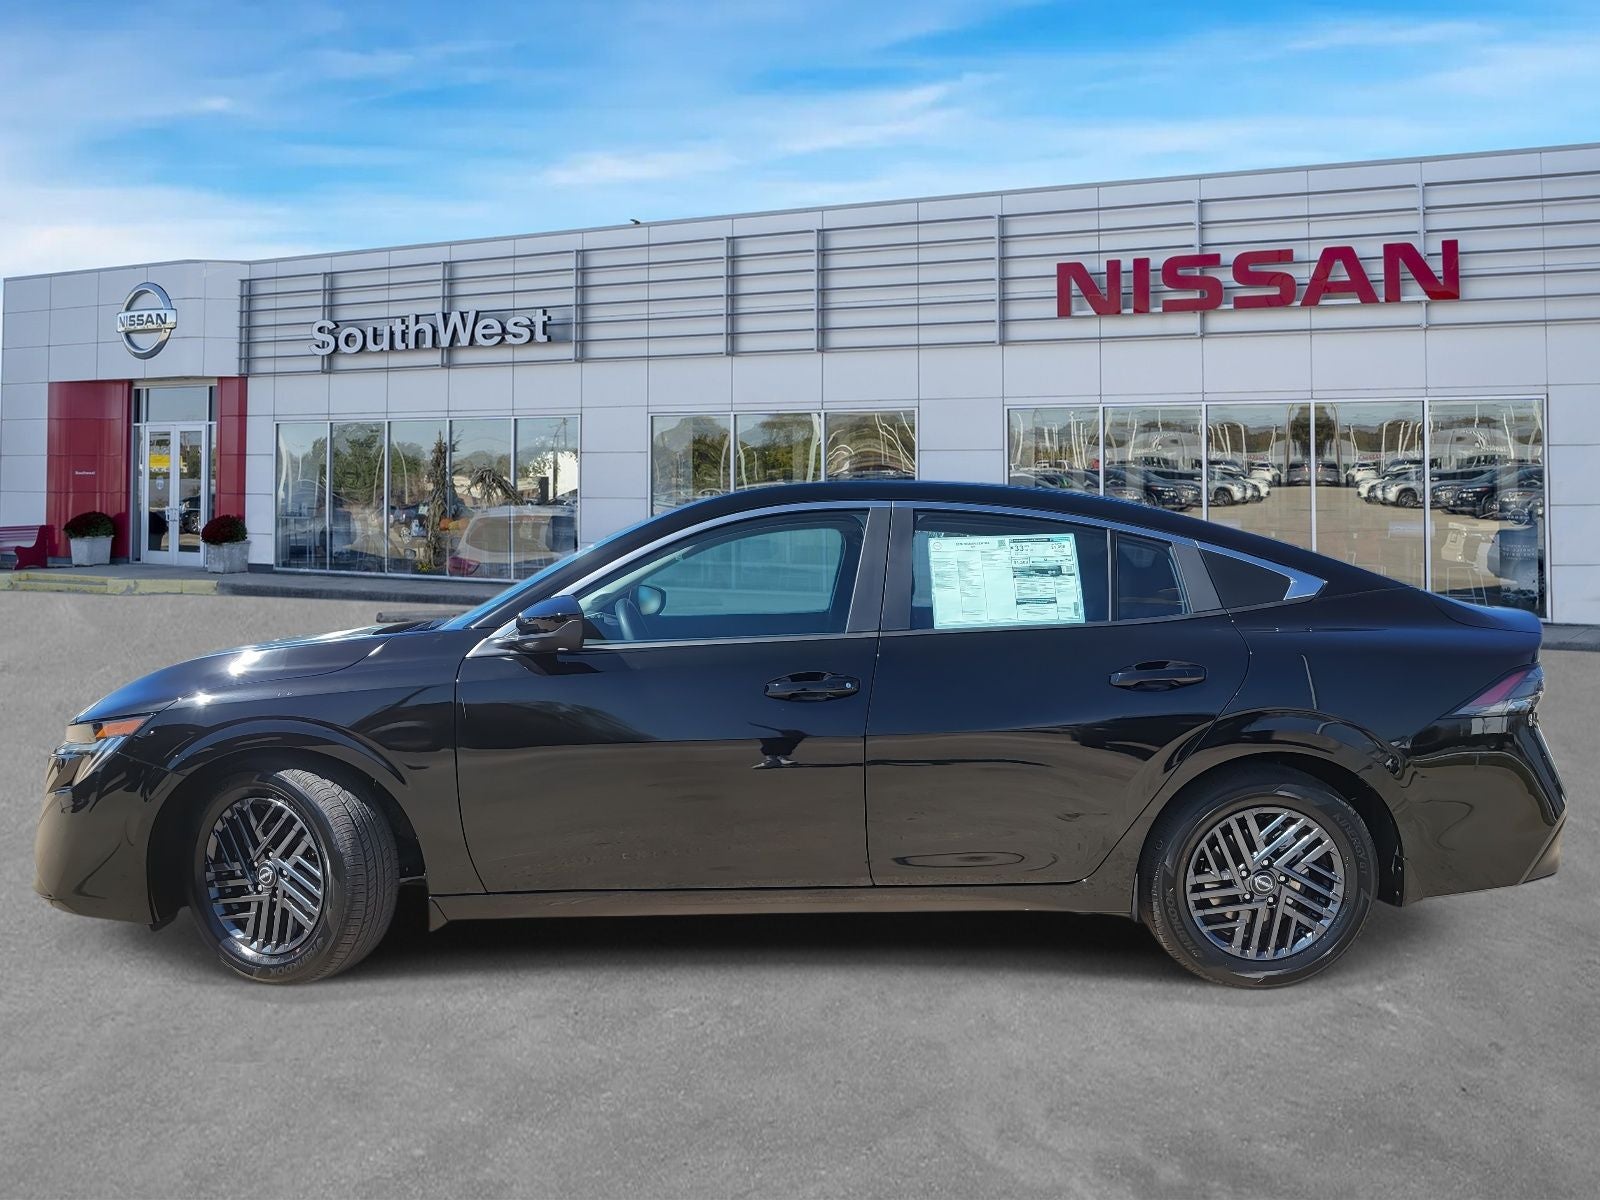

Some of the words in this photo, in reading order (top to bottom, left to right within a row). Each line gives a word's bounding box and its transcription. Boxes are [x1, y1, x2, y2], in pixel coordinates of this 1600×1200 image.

[1056, 239, 1460, 317] NISSAN
[118, 313, 167, 328] NISSAN
[309, 308, 551, 355] SouthWest
